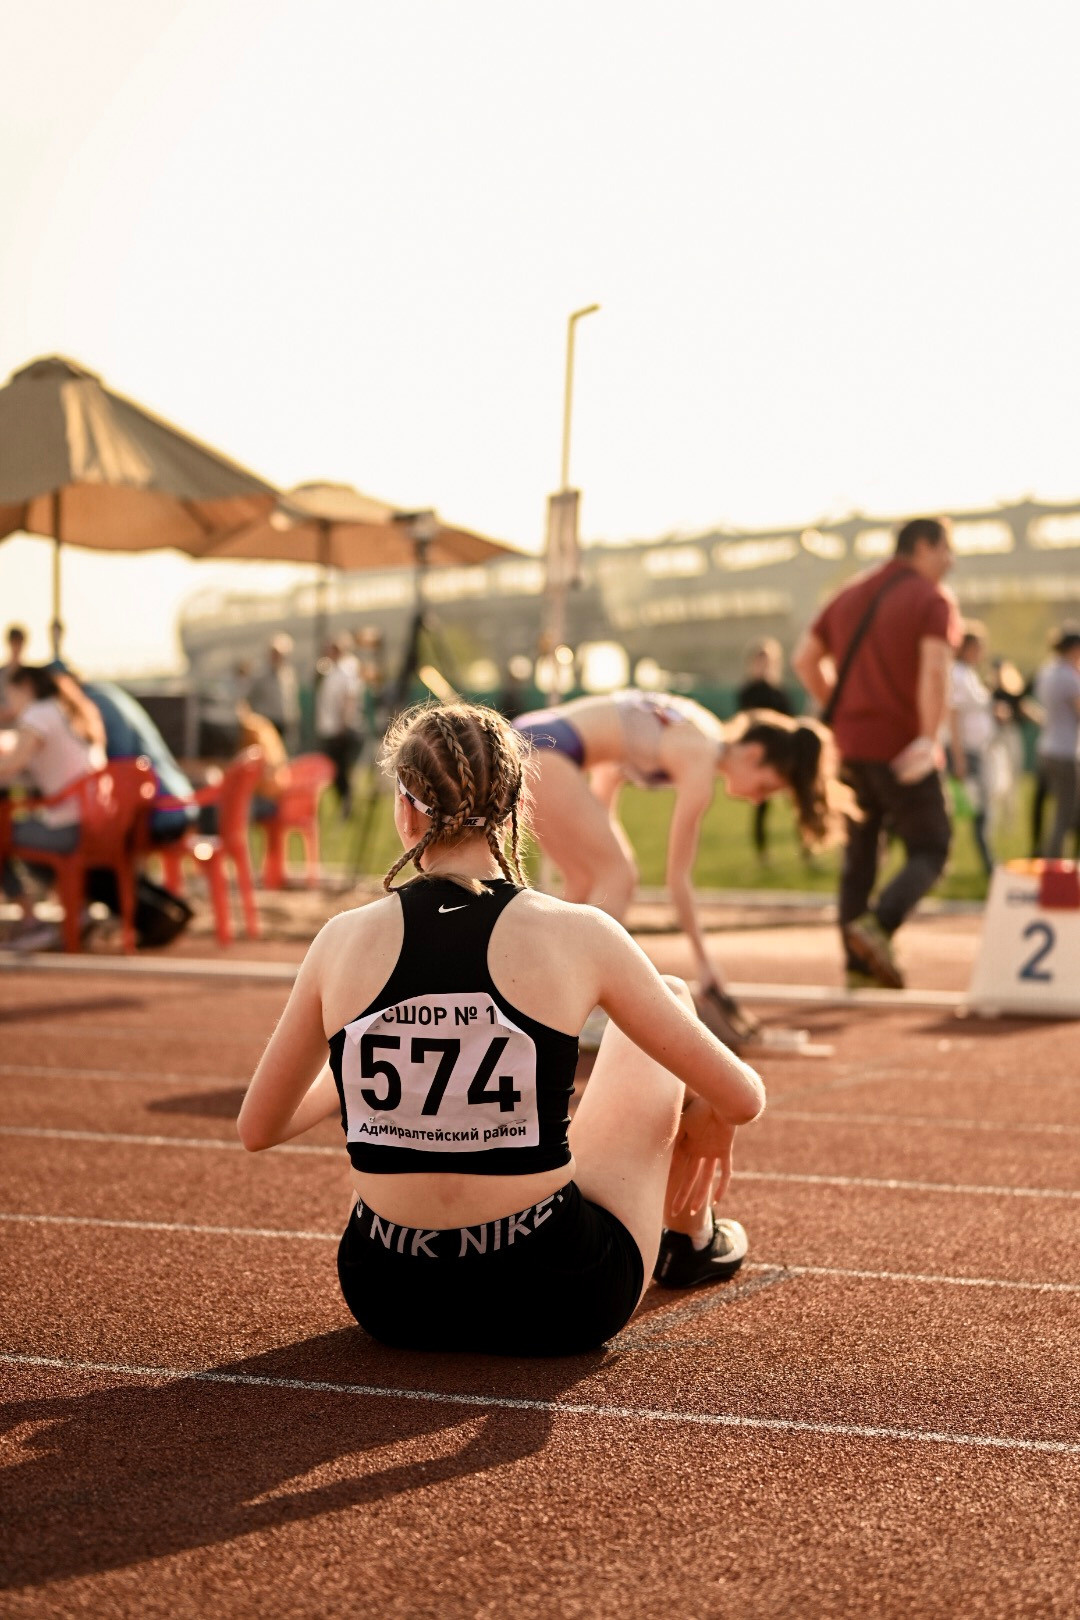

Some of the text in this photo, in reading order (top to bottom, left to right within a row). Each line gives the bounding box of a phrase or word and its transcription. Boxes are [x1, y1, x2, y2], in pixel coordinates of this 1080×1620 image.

[1019, 922, 1055, 981] 2
[382, 1005, 496, 1025] СШОР № 1
[360, 1034, 521, 1116] 574
[359, 1123, 526, 1142] Адмиралтейский район
